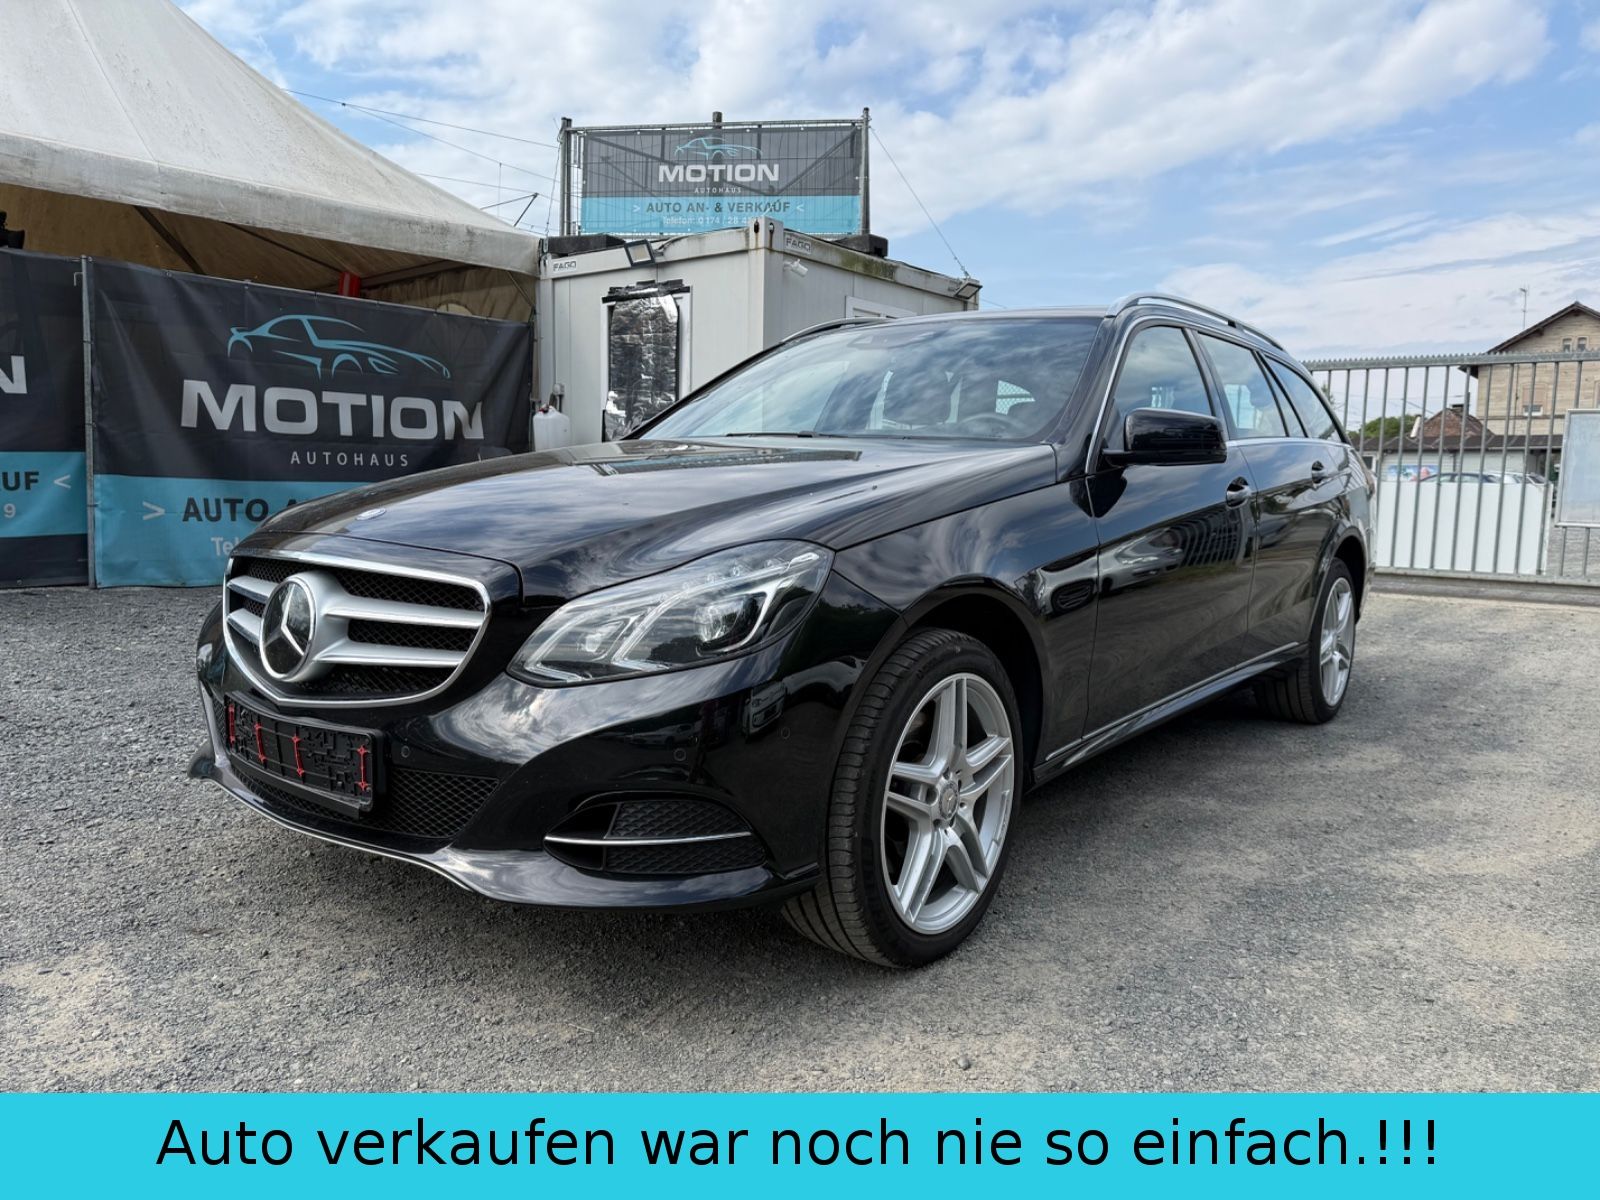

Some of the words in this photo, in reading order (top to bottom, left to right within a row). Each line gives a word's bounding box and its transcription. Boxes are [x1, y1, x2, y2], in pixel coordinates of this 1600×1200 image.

[658, 163, 780, 183] MOTION
[646, 202, 682, 213] AUTO
[687, 202, 710, 213] AN-
[714, 202, 723, 213] &
[727, 201, 791, 213] VERKAUF
[181, 379, 484, 441] MOTION
[290, 451, 409, 467] AUTOHAUS
[182, 497, 269, 522] AUTO
